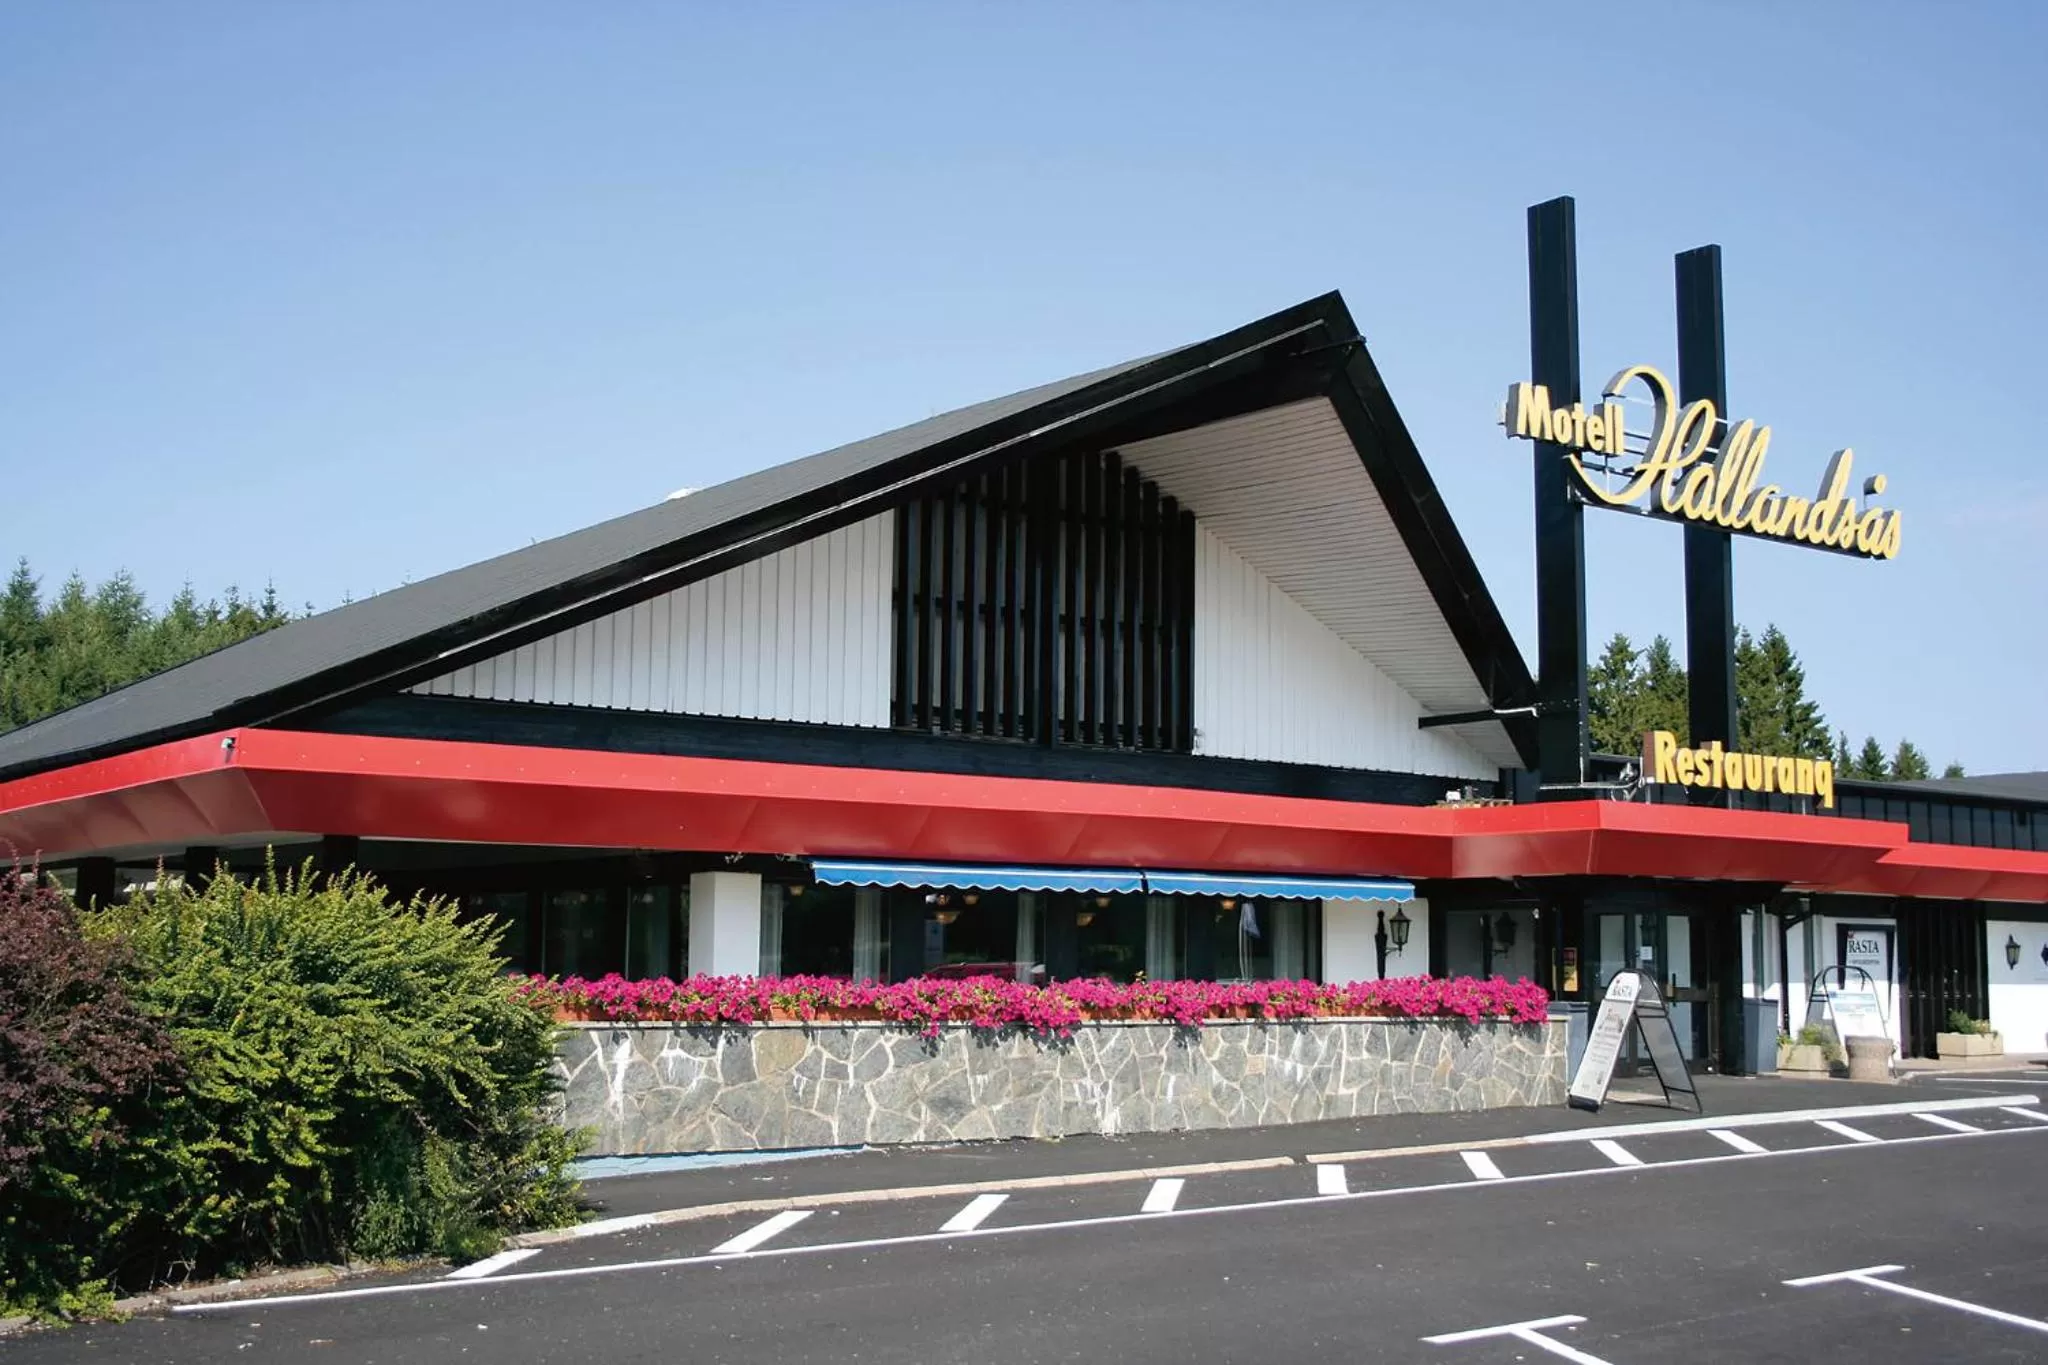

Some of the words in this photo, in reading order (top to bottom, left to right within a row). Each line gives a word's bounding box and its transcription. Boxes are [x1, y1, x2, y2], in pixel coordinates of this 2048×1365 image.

[1508, 382, 1624, 456] Motell
[1648, 730, 1834, 808] Restaurang
[1848, 939, 1880, 953] RASTA
